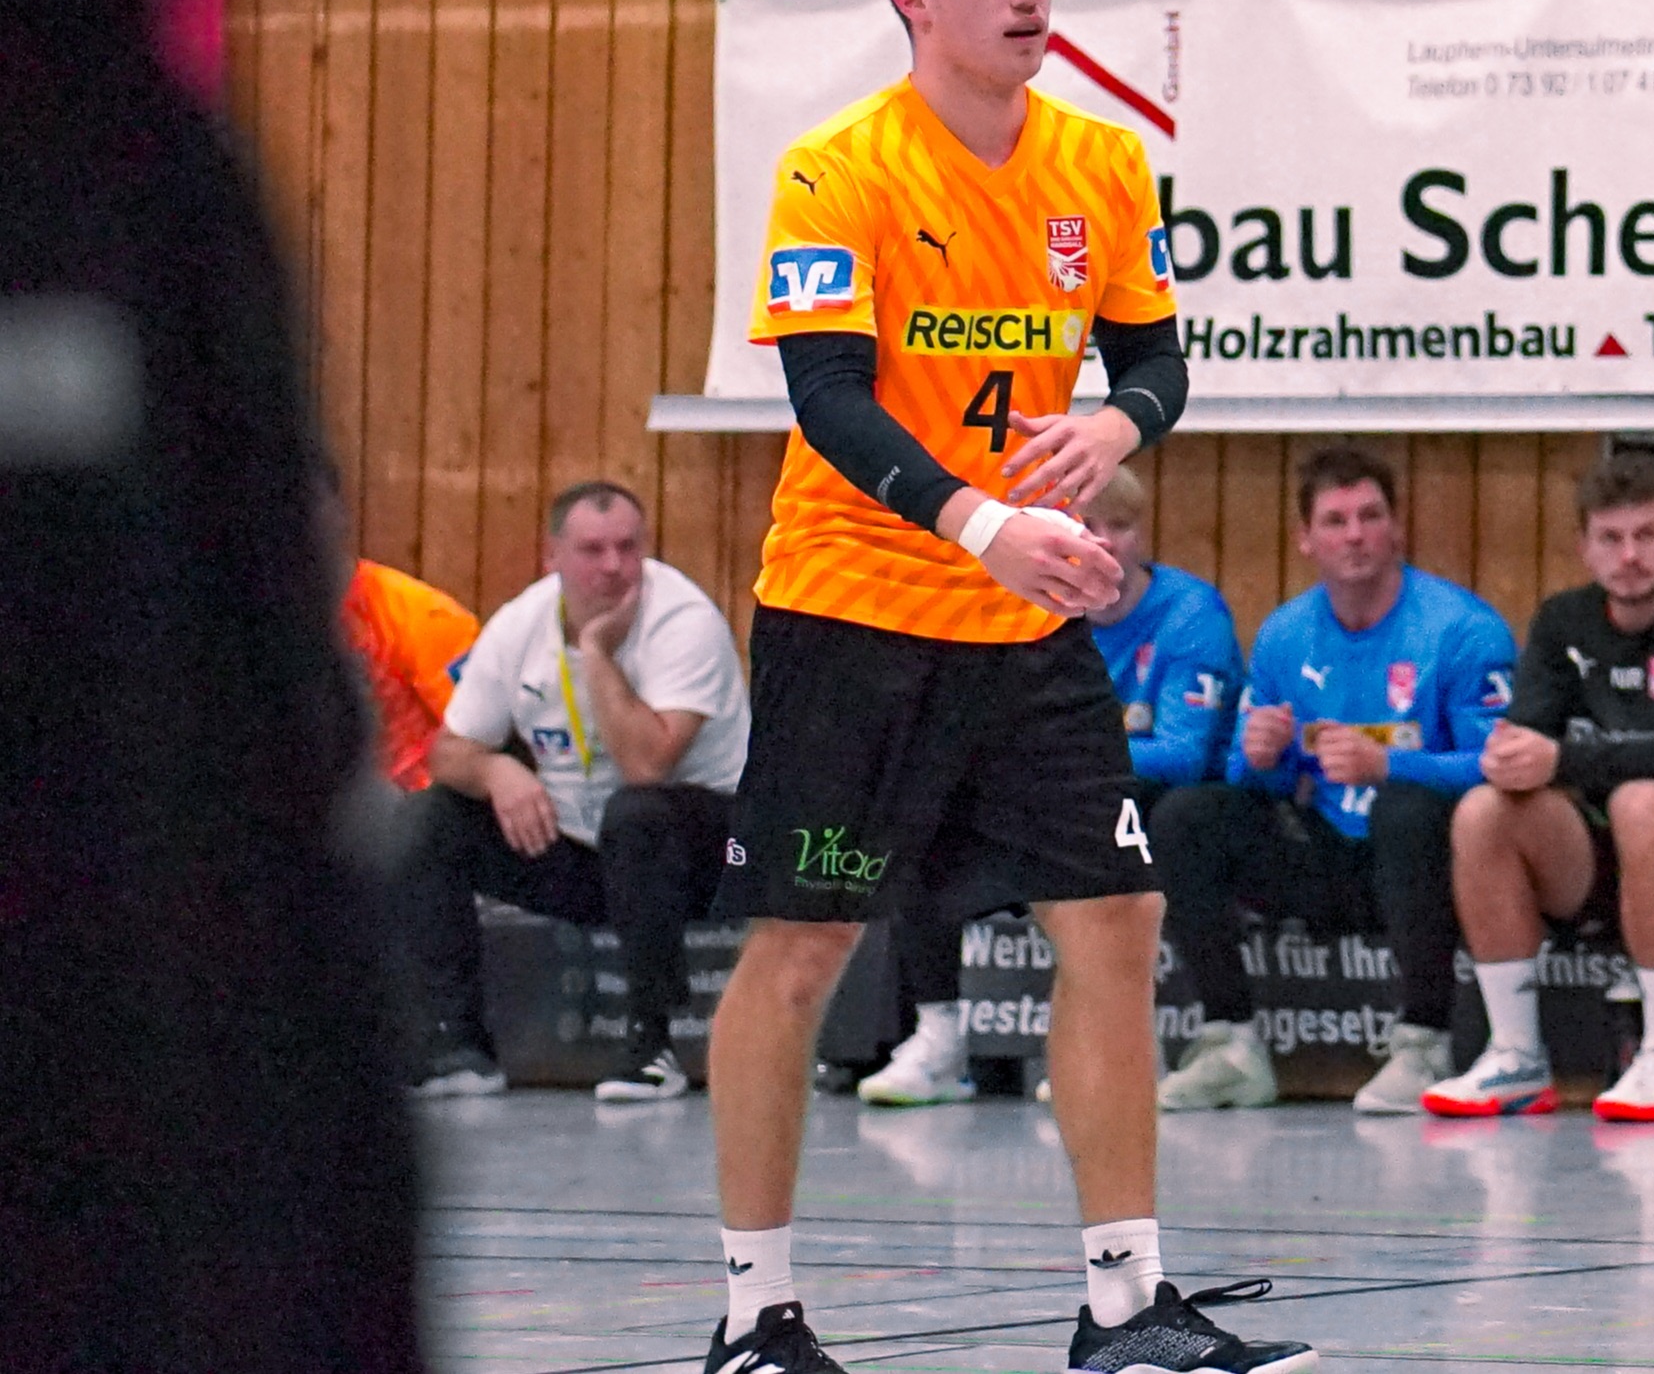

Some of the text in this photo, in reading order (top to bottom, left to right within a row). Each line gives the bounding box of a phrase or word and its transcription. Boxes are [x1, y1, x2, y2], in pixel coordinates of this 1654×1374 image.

[1048, 219, 1083, 237] TSV
[1160, 173, 1355, 282] bau
[1182, 310, 1577, 363] Holzrahmenbau
[961, 370, 1015, 454] 4
[1115, 797, 1154, 865] 4
[962, 924, 1053, 969] Werb
[1274, 932, 1330, 976] für
